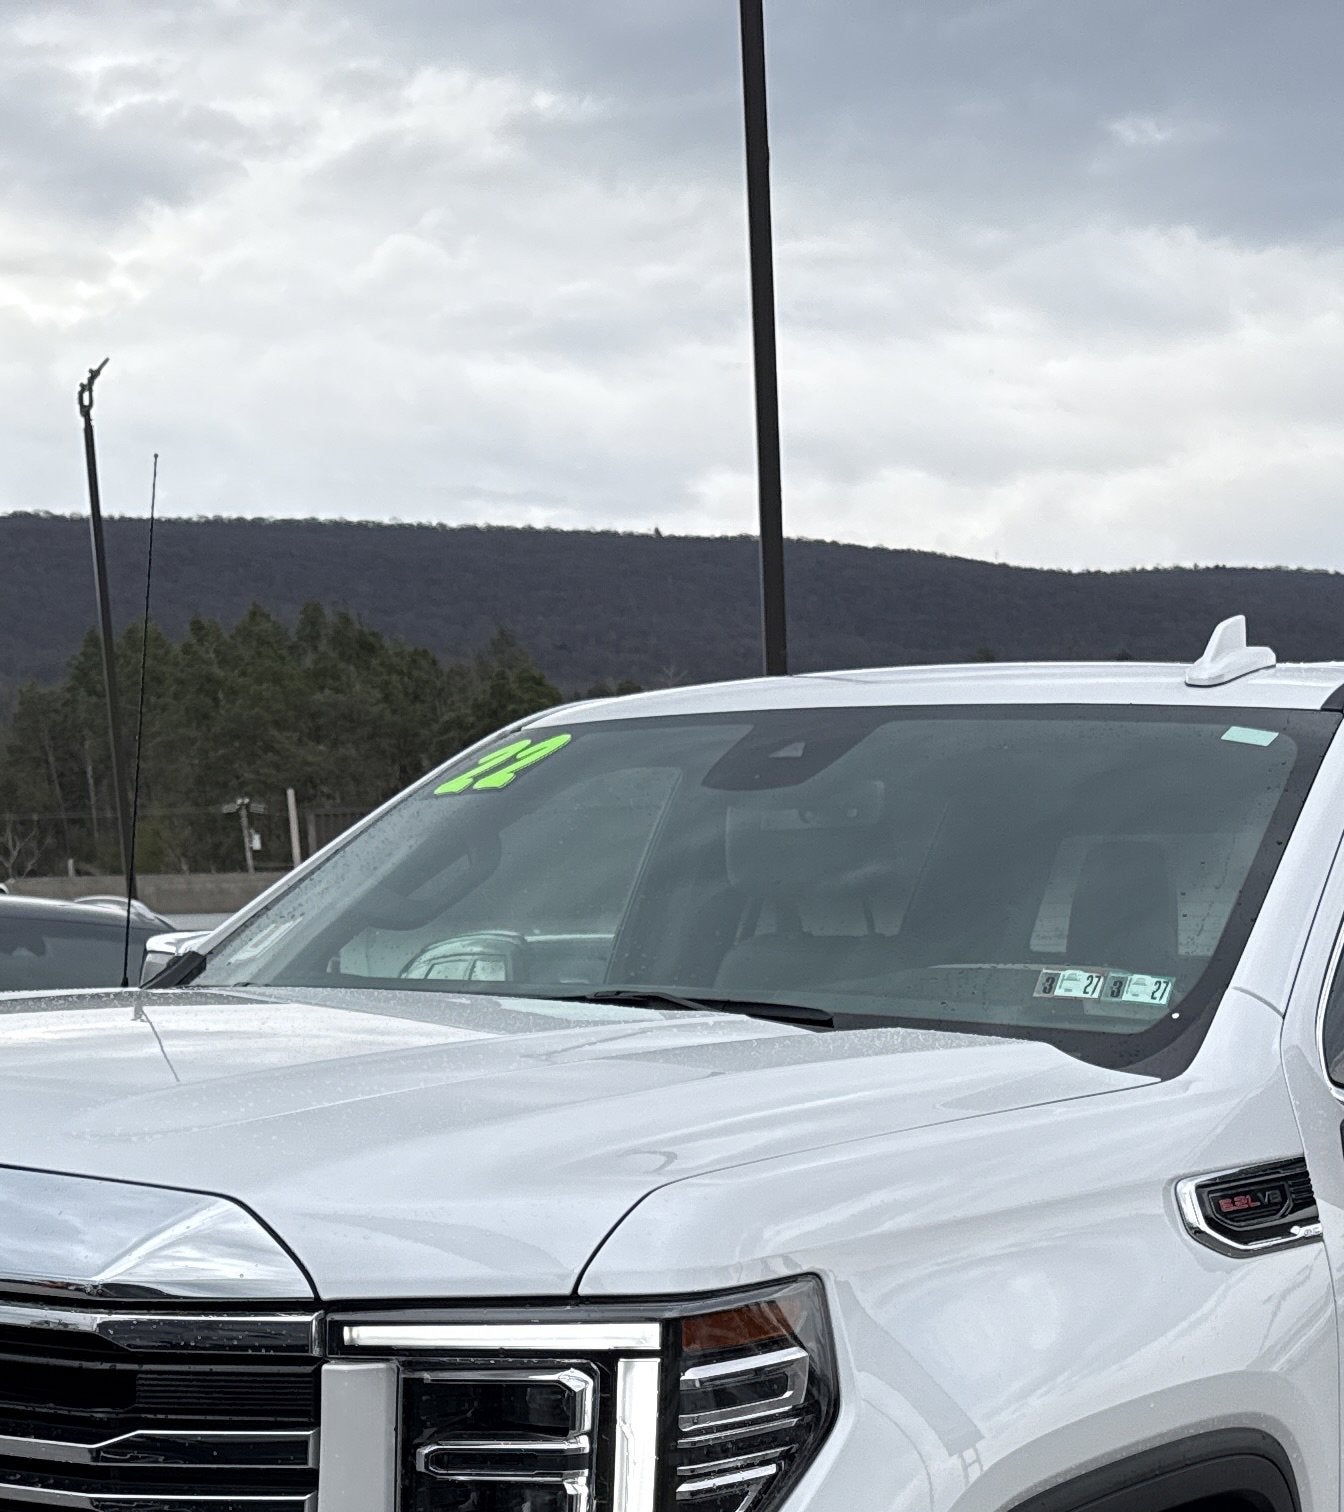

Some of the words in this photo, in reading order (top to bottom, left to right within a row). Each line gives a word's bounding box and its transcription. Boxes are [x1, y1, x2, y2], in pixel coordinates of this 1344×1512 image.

[433, 733, 573, 795] 22
[1042, 976, 1056, 995] 3
[1082, 974, 1102, 997] 27
[1109, 979, 1123, 998] 3
[1150, 980, 1170, 1002] 27
